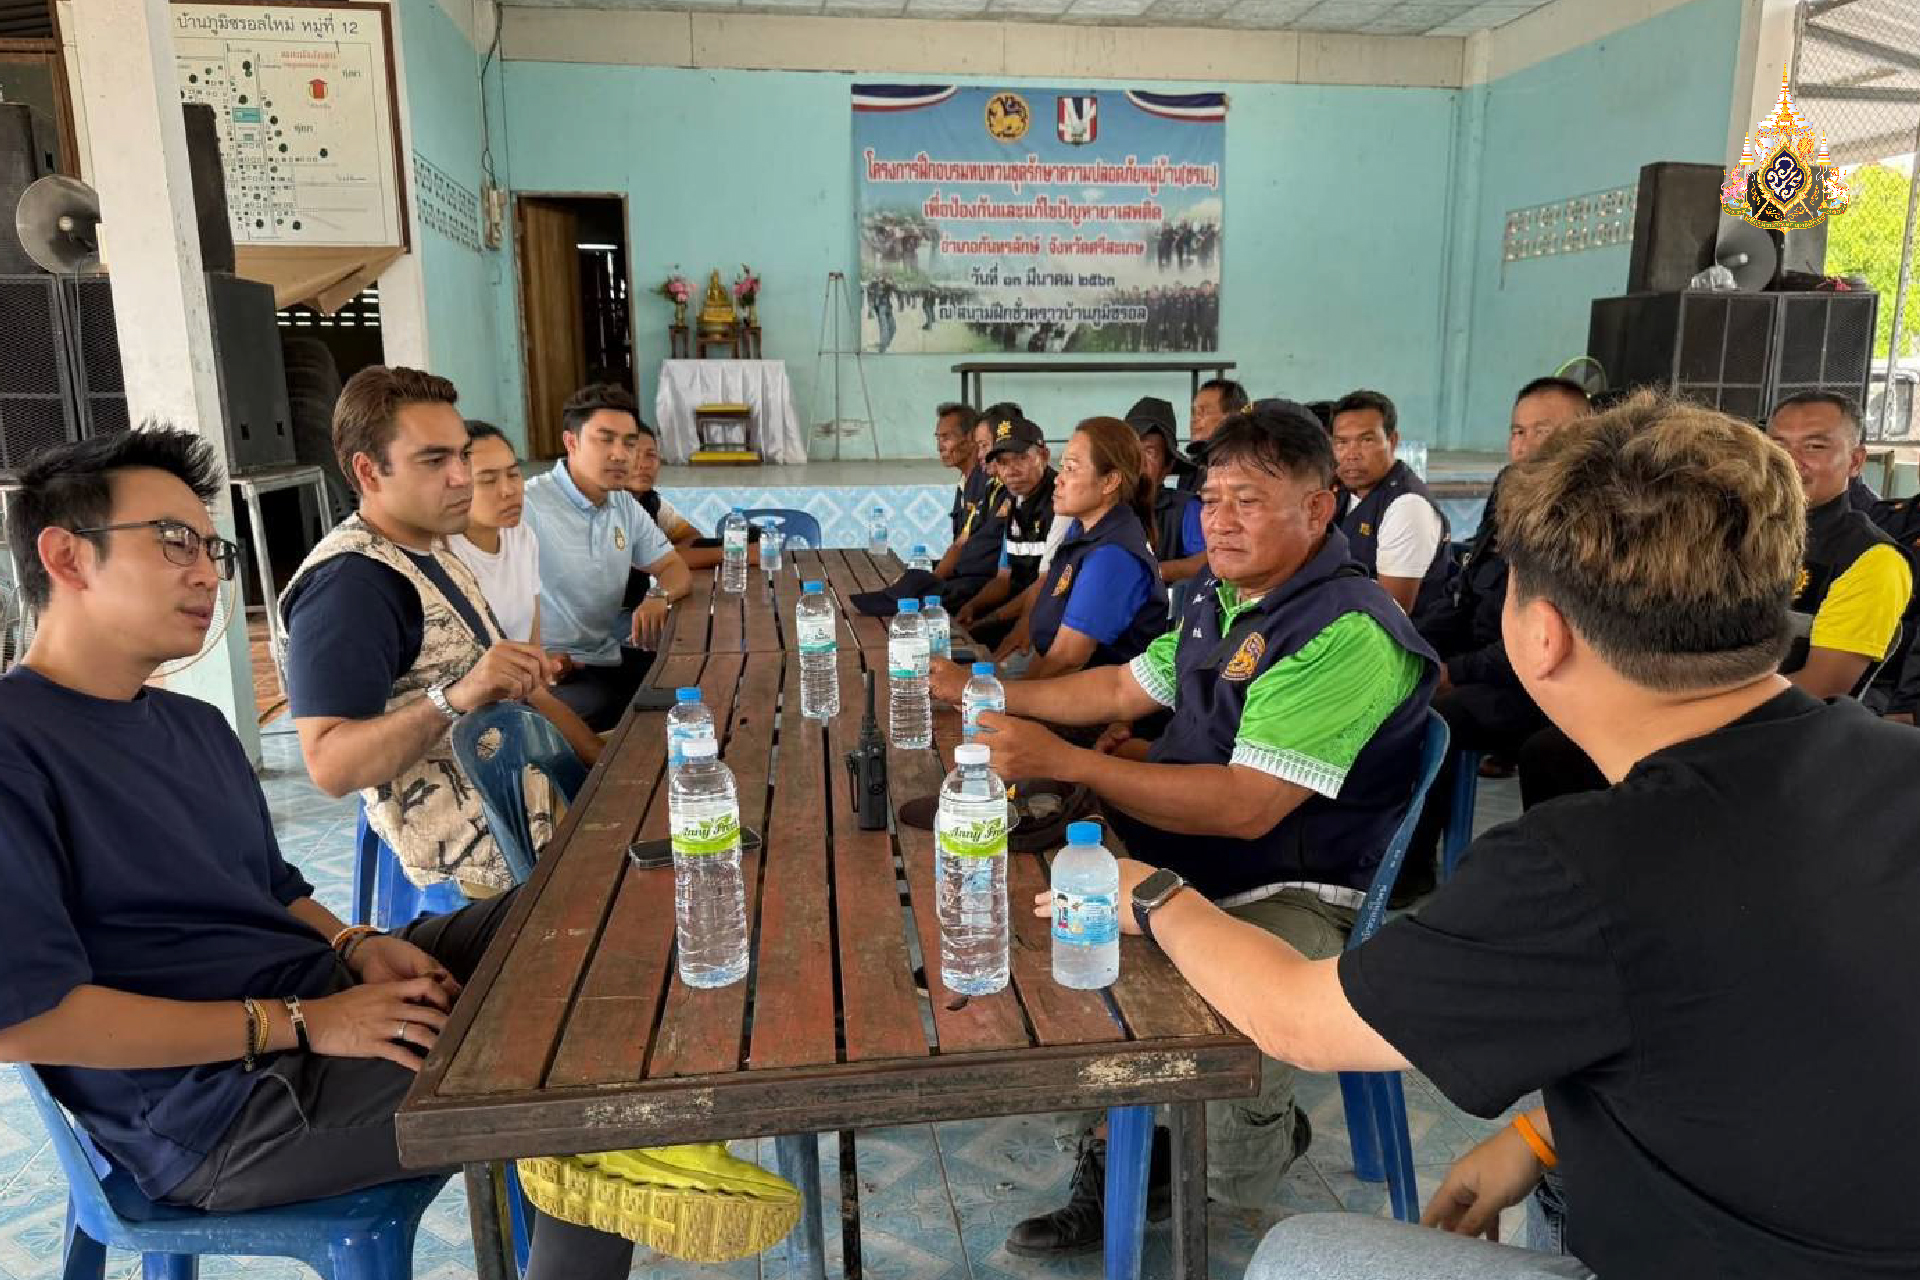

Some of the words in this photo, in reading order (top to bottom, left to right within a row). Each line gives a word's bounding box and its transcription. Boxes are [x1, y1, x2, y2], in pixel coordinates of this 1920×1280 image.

[302, 11, 335, 38] หมู่ที่
[342, 21, 359, 34] 12
[923, 193, 1162, 227] เพื่อป้องกันและแก้ไขปัญหายาเสพติด
[971, 261, 998, 286] วันที่
[1025, 266, 1073, 286] มีนาคม
